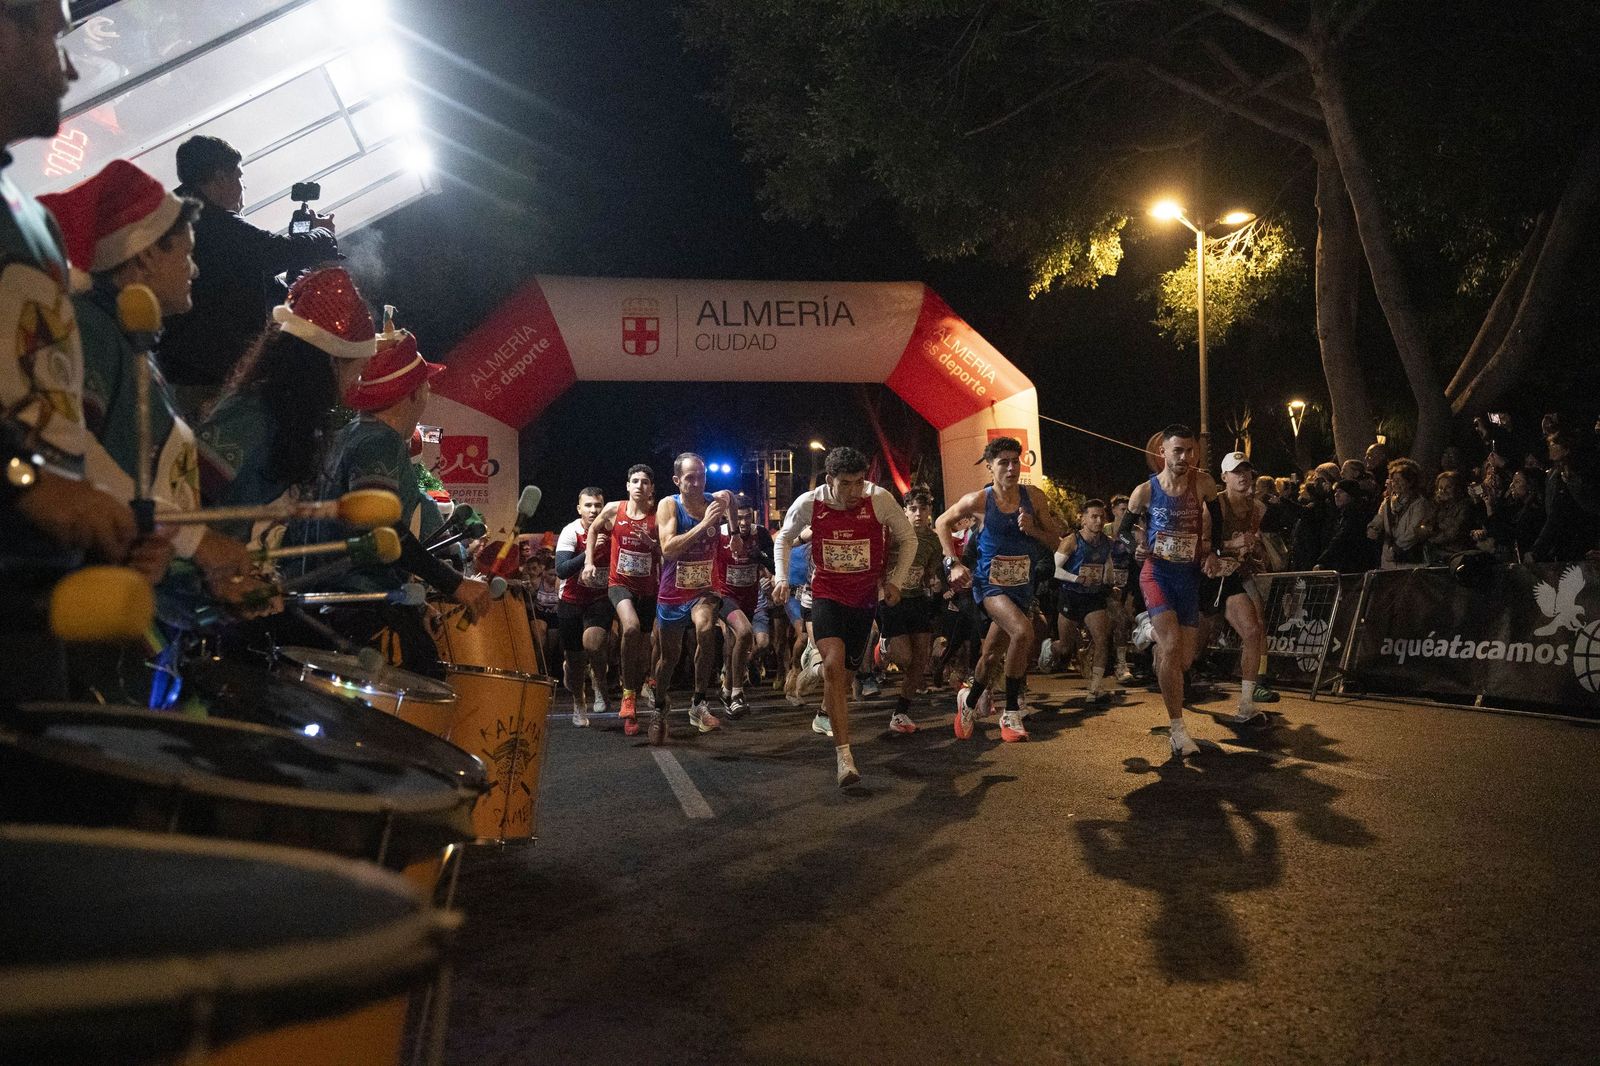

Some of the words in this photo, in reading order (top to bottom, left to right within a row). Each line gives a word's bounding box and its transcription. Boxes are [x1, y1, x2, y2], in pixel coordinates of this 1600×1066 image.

[696, 295, 855, 327] ALMERÍA
[471, 325, 537, 389] ALMERÍA
[695, 333, 777, 351] CIUDAD
[933, 327, 997, 384] ALMERÍA
[484, 383, 502, 401] es
[500, 338, 550, 385] deporte
[922, 340, 939, 356] es
[938, 352, 986, 396] deporte
[449, 489, 489, 497] EPORTES
[833, 553, 859, 561] 2267
[1380, 631, 1569, 666] aquéatacamos
